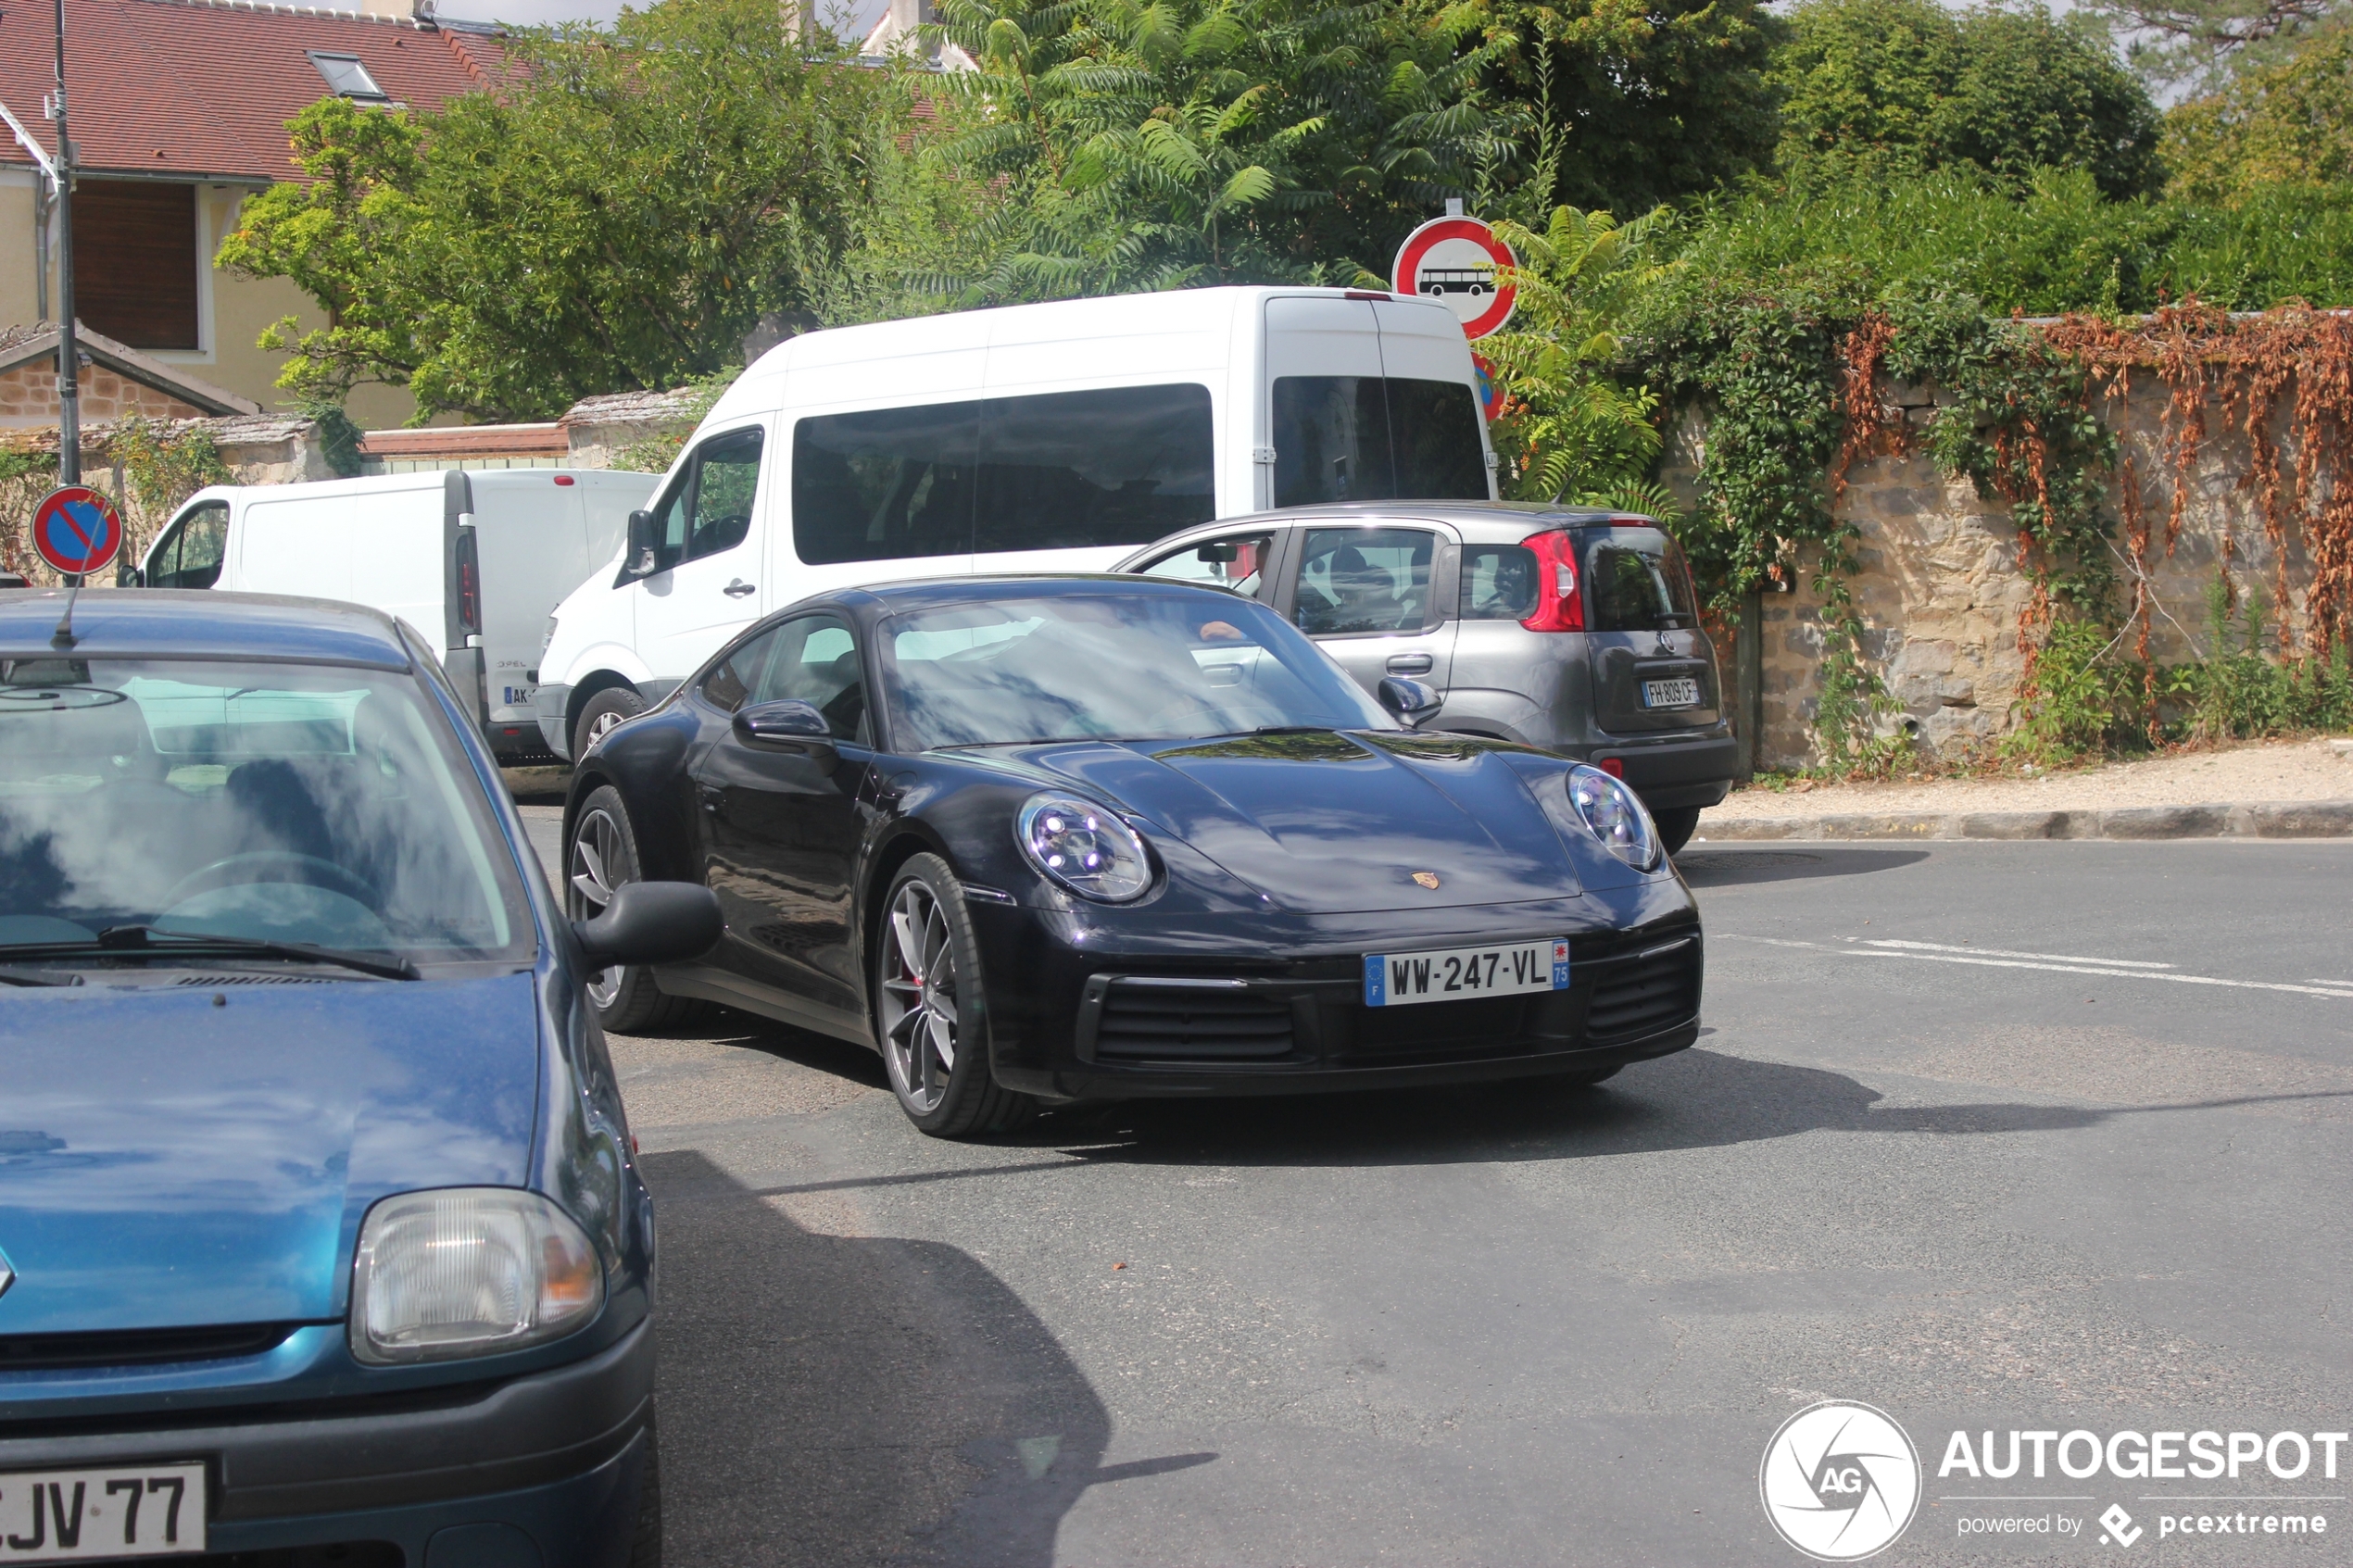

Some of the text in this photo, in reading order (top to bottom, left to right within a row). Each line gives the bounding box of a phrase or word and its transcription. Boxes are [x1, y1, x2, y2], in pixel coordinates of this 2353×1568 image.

[514, 688, 536, 703] AK-
[1648, 682, 1692, 704] FH-809-CF
[1392, 949, 1547, 996] WW-247-VL
[1554, 966, 1567, 983] 75
[1372, 985, 1378, 996] F
[0, 1476, 184, 1549] JV 77
